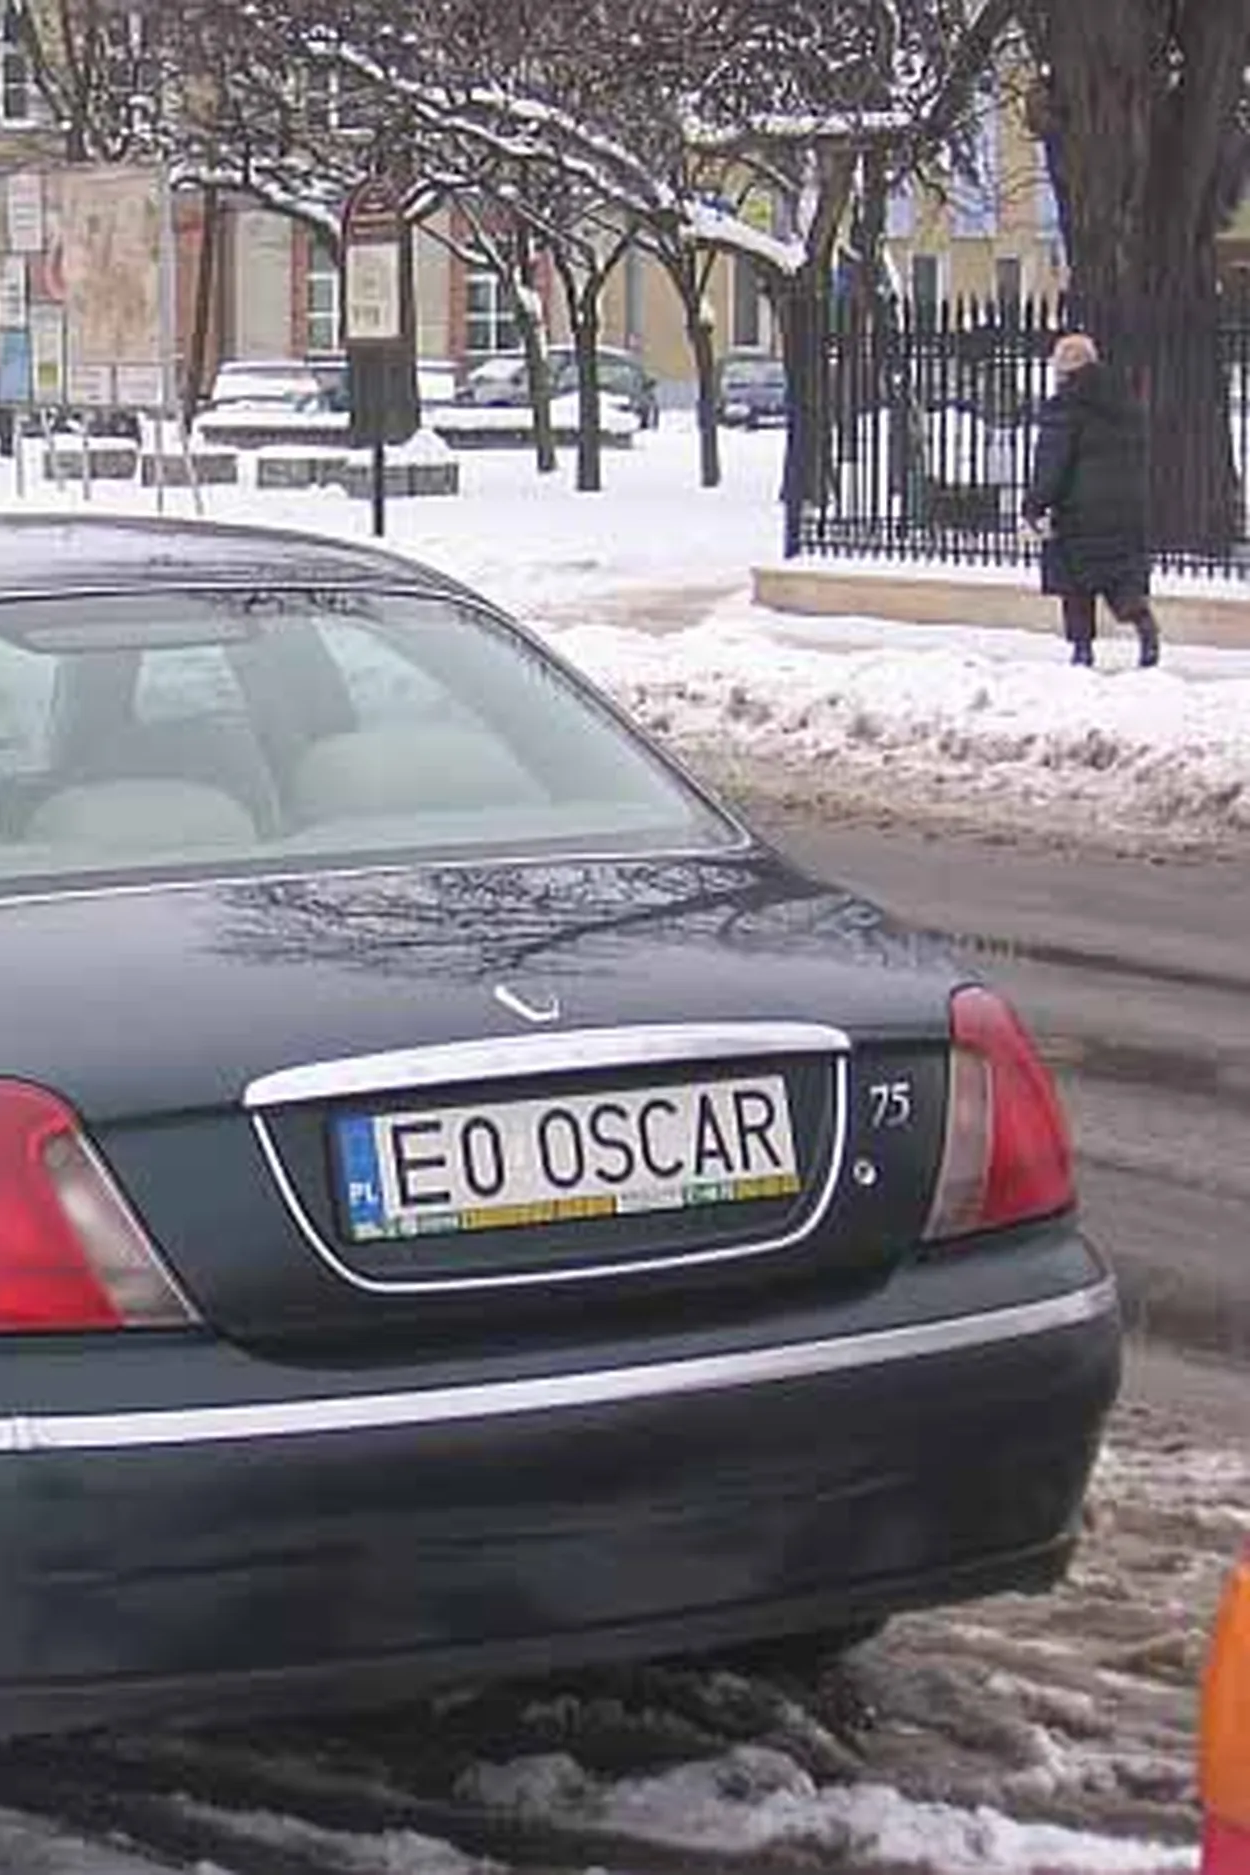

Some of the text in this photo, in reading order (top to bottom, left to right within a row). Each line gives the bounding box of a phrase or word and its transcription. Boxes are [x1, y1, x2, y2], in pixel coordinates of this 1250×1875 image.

[870, 1082, 910, 1127] 75
[537, 1089, 784, 1190] OSCAR
[350, 1182, 379, 1204] PL
